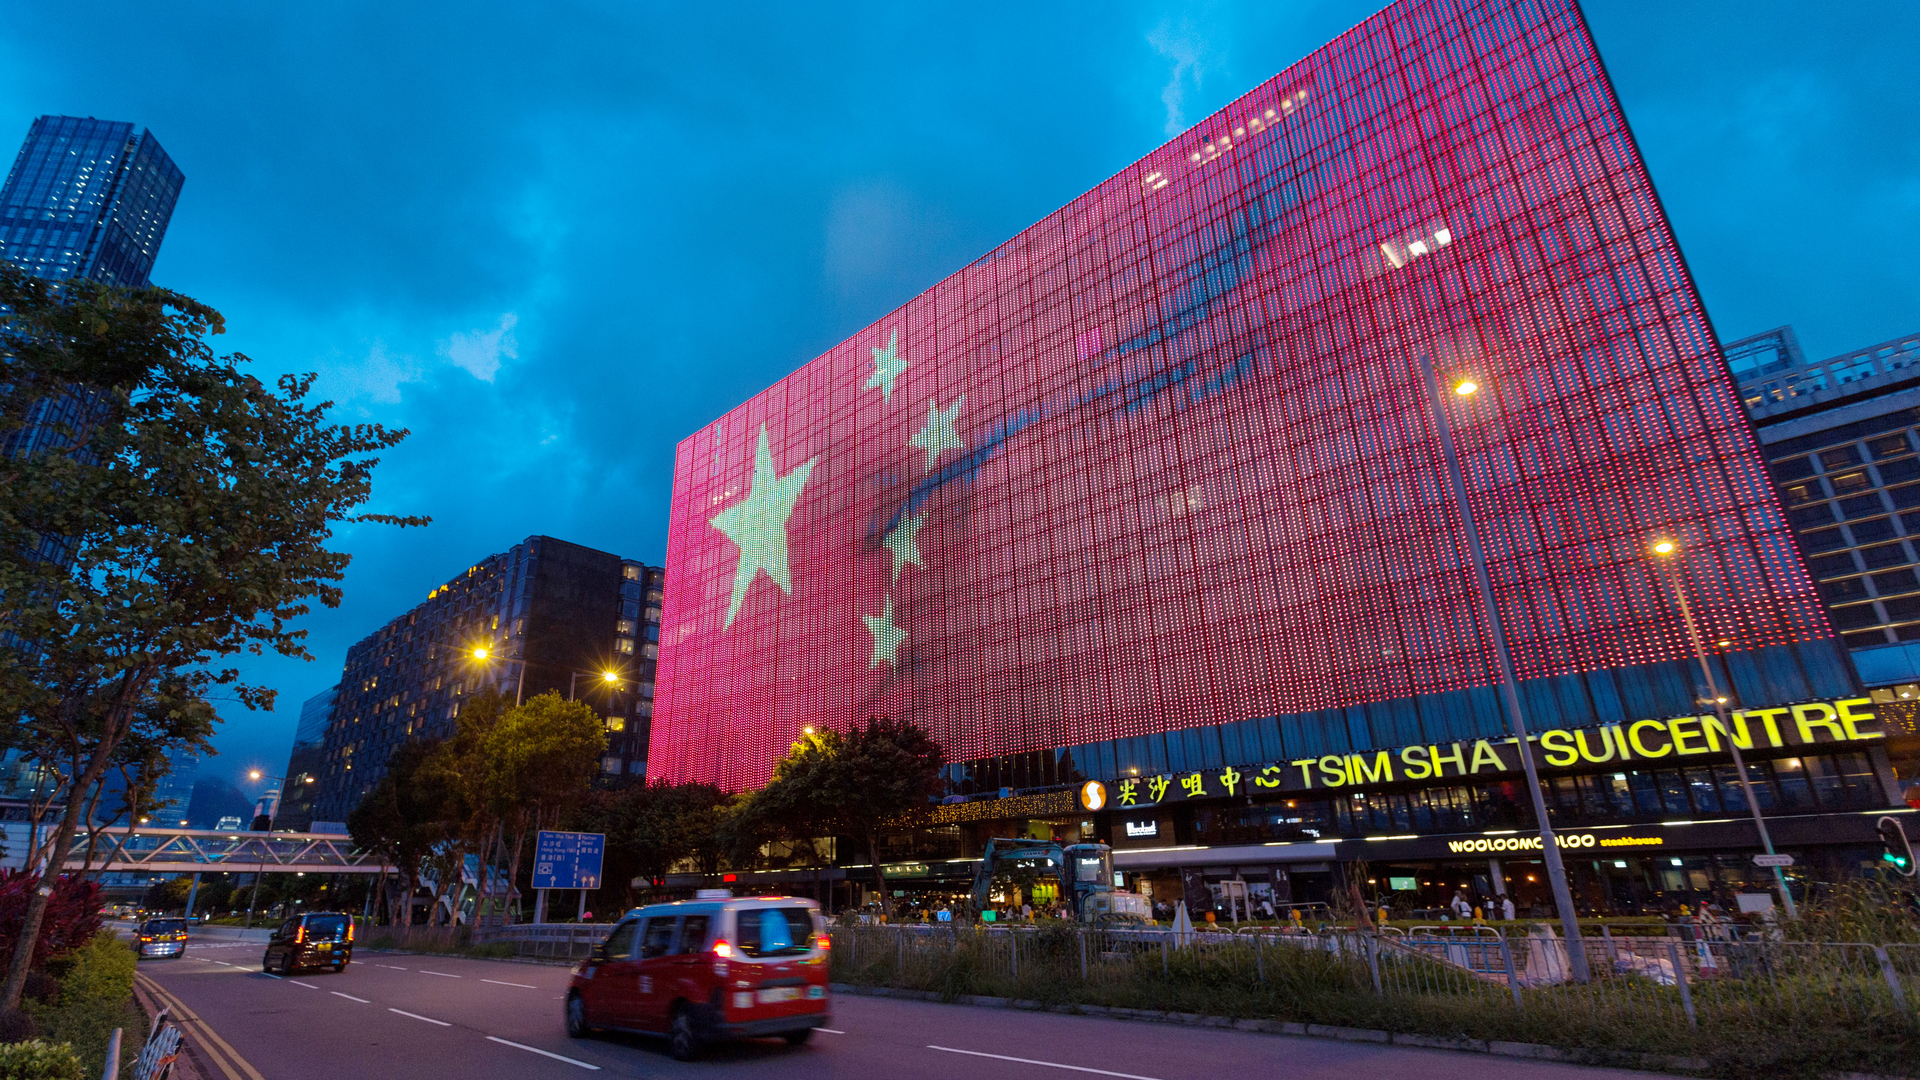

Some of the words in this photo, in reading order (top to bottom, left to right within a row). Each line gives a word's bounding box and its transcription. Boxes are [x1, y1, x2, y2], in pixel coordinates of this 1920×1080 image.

[1292, 750, 1394, 789] TSIM
[1401, 739, 1508, 779] SHA
[1600, 836, 1664, 847] steakhouse
